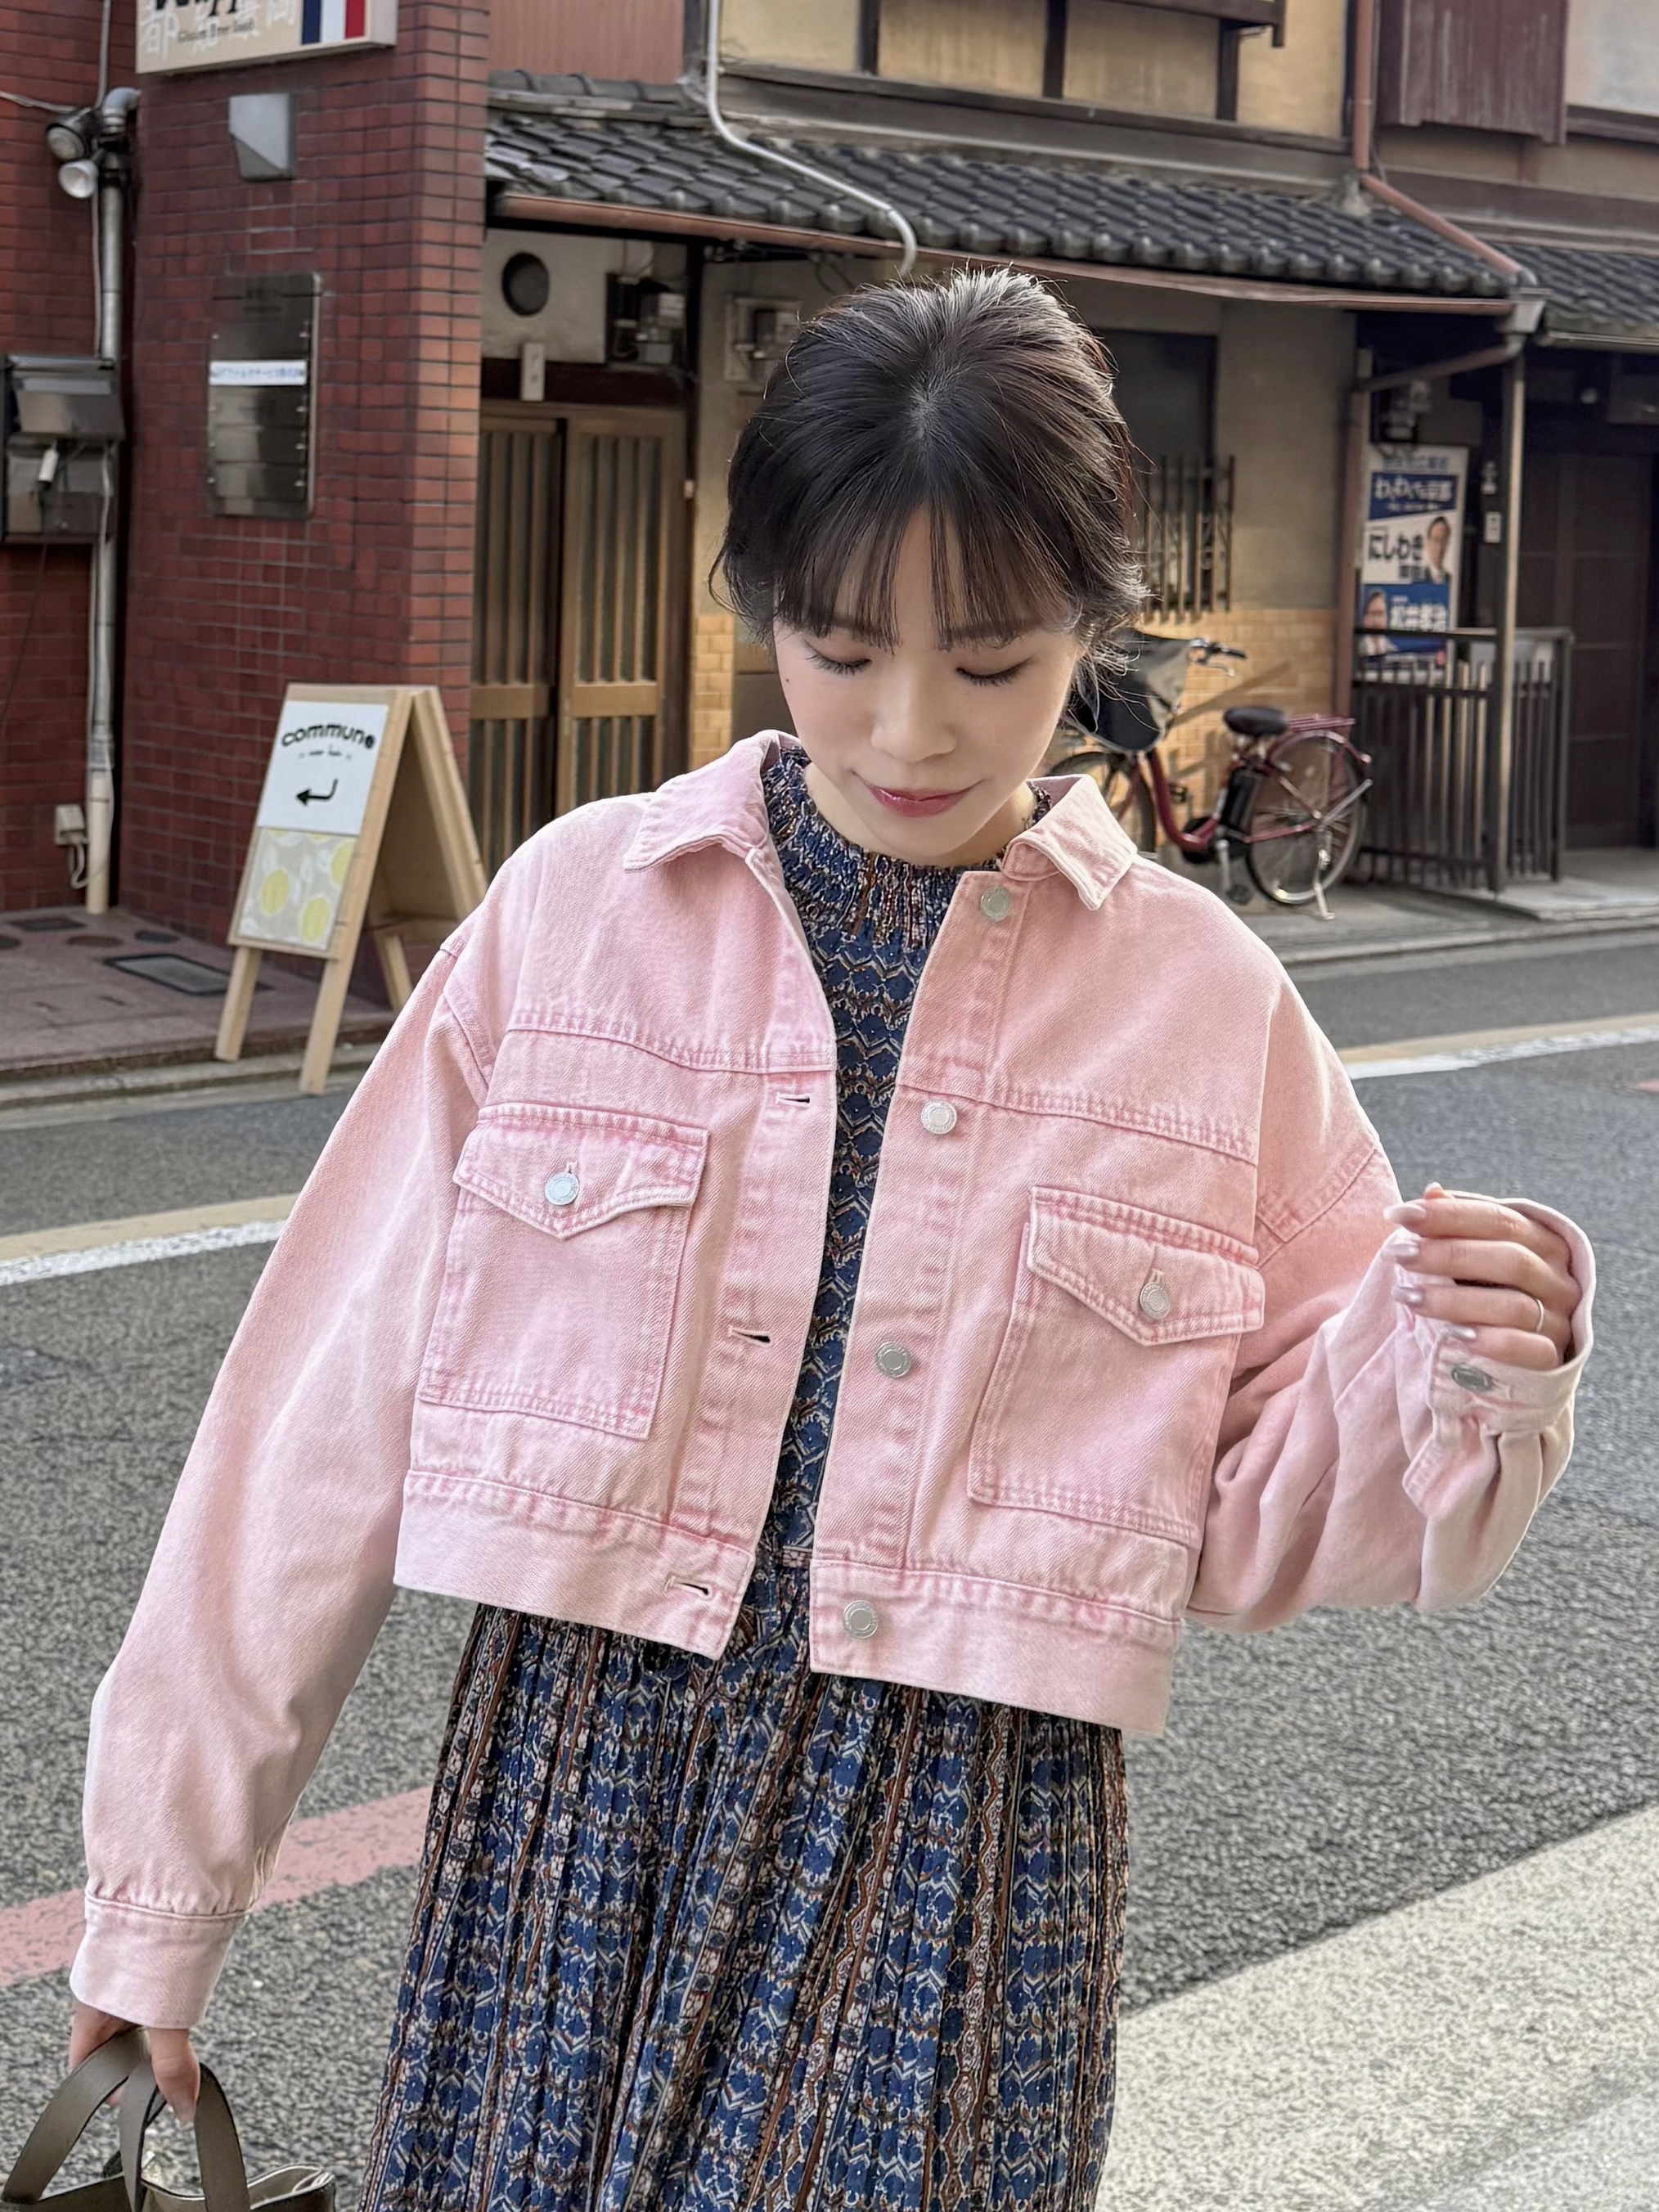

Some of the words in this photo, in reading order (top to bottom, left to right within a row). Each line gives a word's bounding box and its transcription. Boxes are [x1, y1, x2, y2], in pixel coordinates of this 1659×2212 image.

[1367, 533, 1423, 561] にしわき
[281, 724, 375, 749] commune
